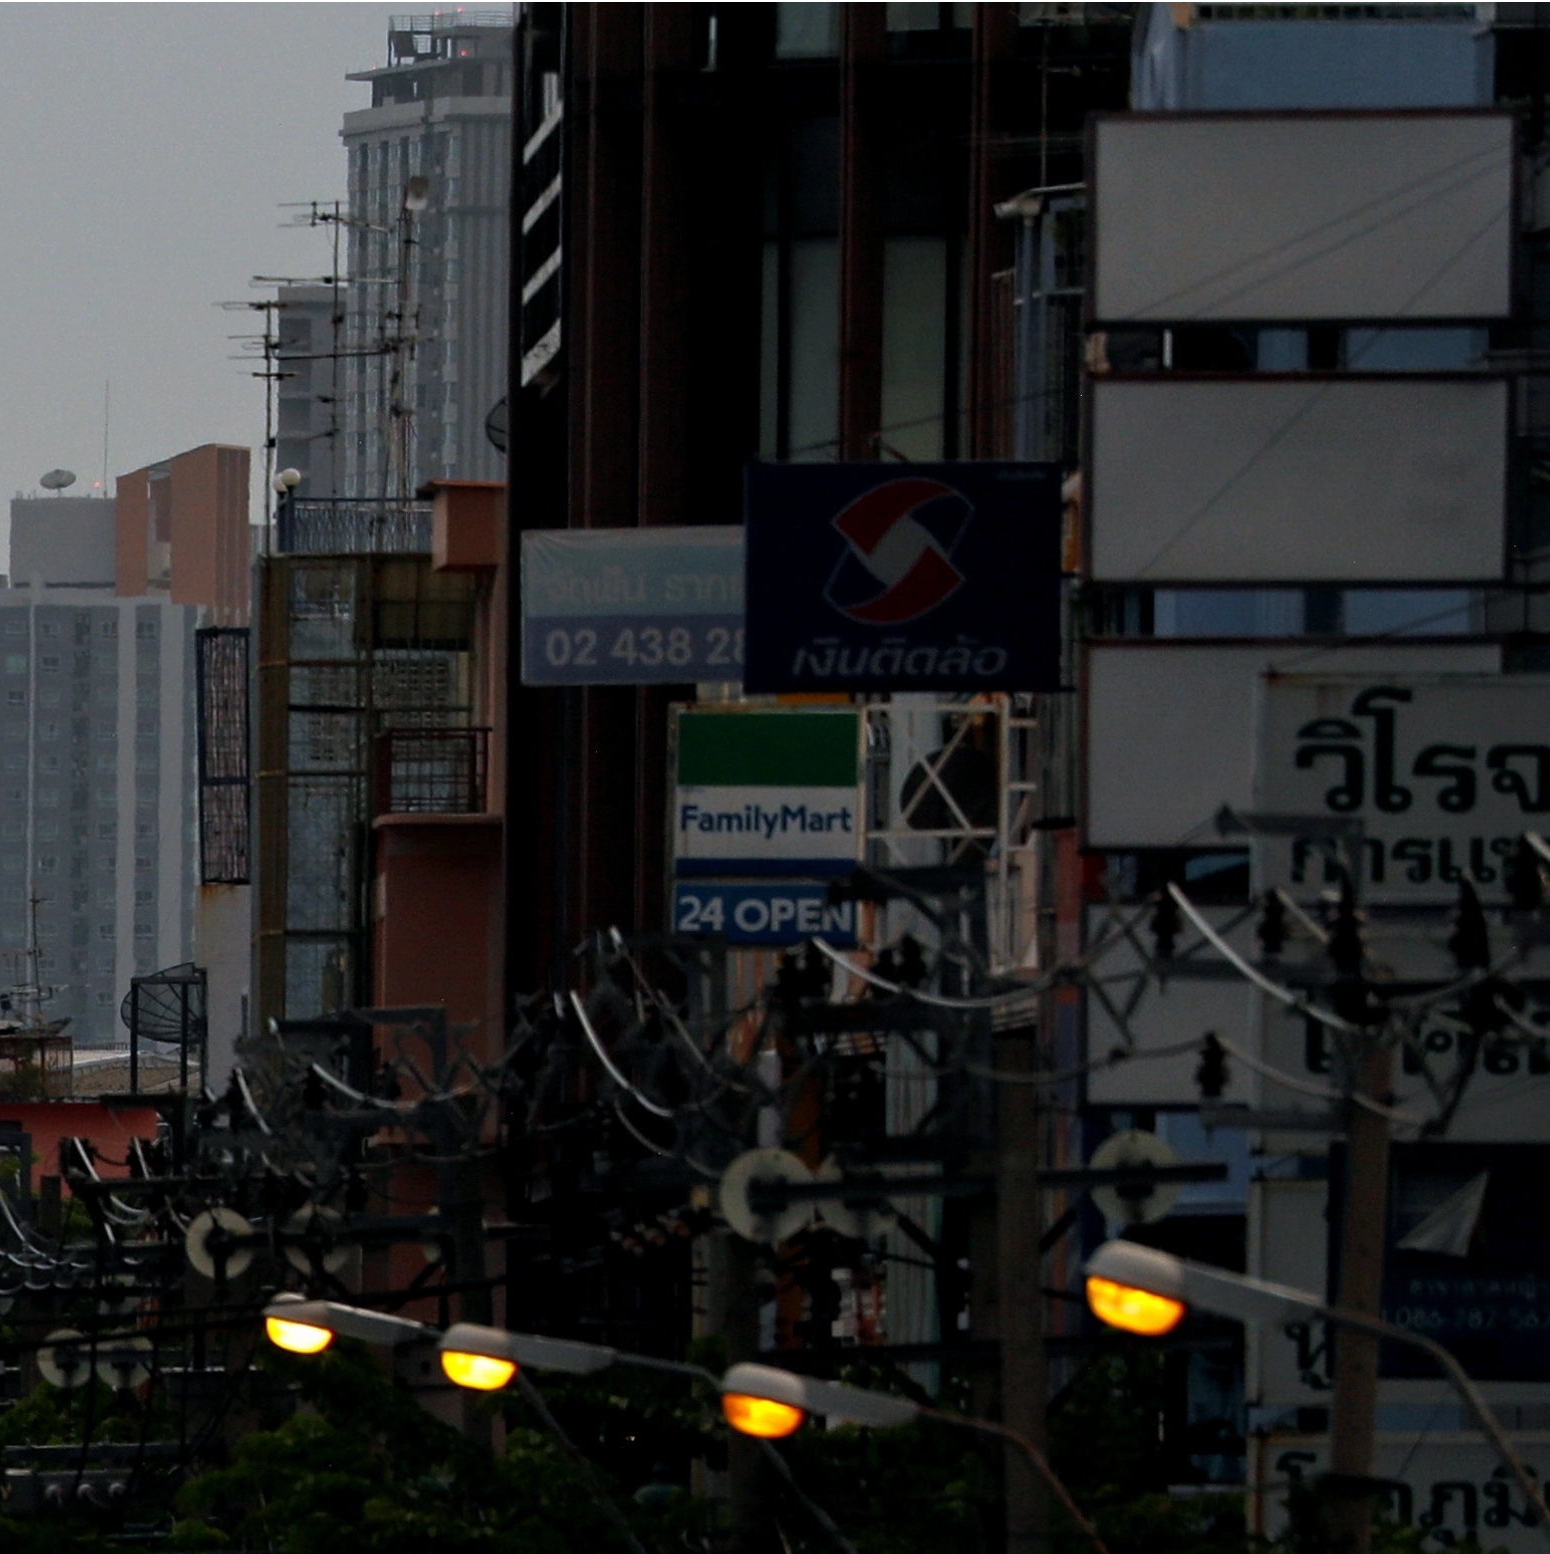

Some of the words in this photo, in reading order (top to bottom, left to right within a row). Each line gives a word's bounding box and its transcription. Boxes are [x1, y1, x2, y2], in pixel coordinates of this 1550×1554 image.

[545, 627, 598, 667] 02
[610, 627, 692, 667] 438
[791, 636, 1009, 680] เงินติดล้อ
[680, 804, 853, 839] FamilyMart
[678, 894, 726, 933] 24
[733, 894, 854, 935] OPEN
